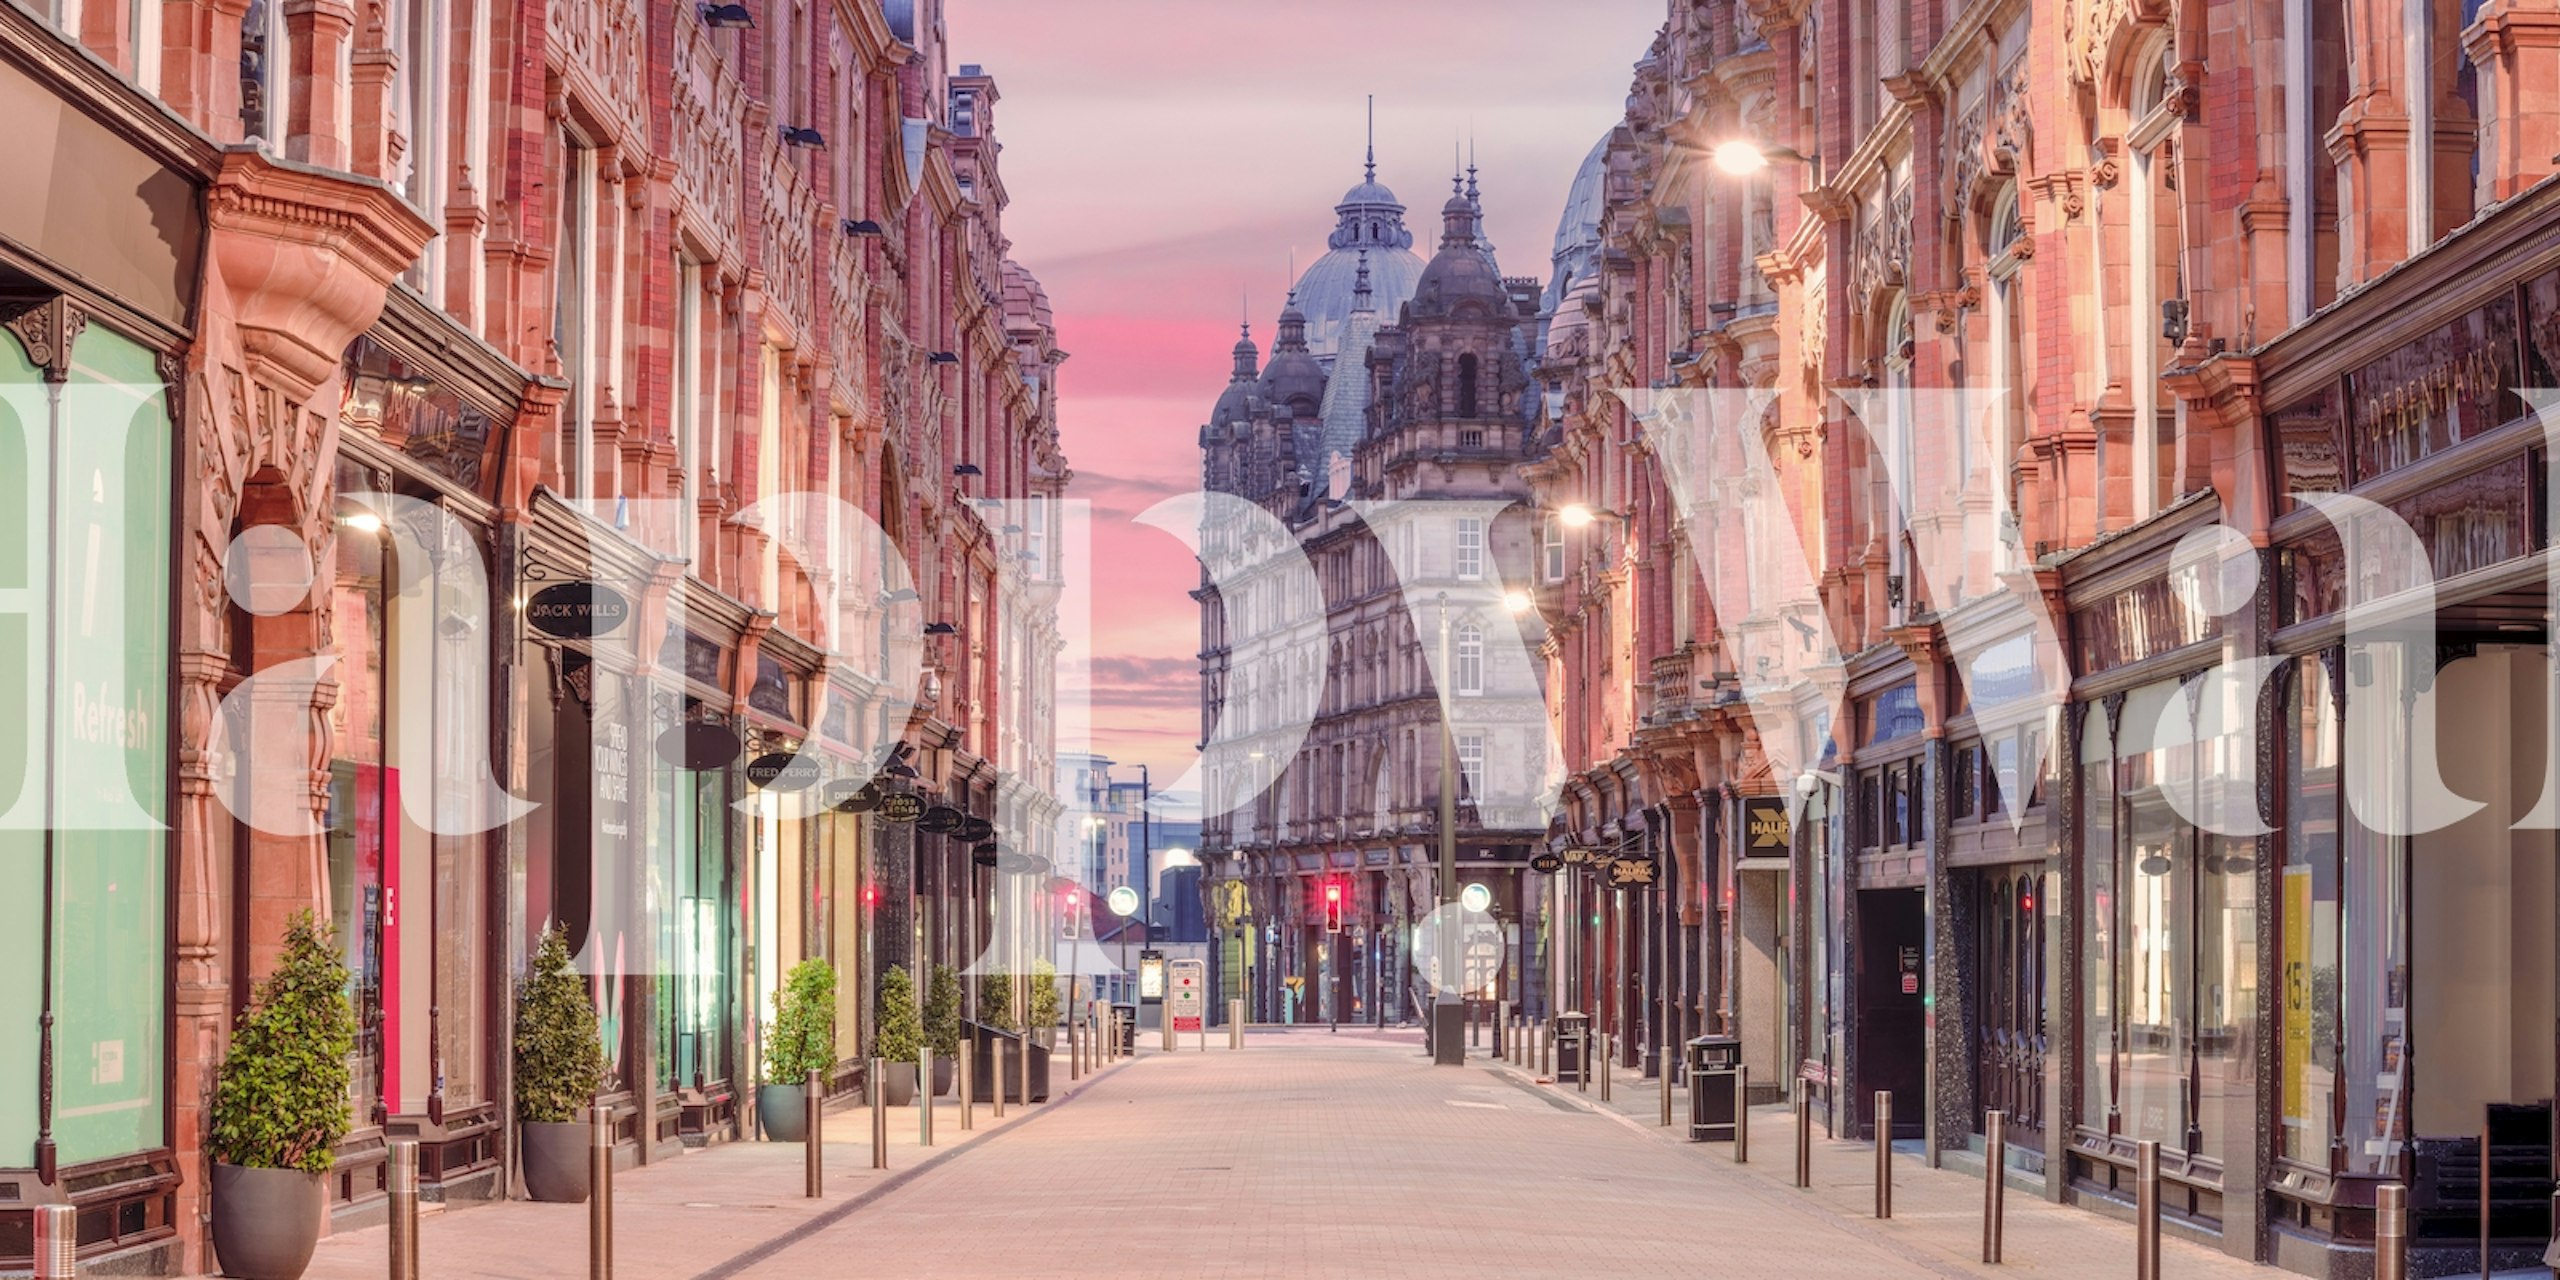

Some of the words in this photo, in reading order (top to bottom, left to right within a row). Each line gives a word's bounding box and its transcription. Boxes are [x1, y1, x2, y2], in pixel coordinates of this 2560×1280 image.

[2368, 341, 2500, 442] DEBENHAMS
[532, 603, 572, 618] JACK
[576, 603, 620, 618] WILLS
[73, 680, 148, 751] Refresh
[749, 767, 780, 778] FRED
[781, 767, 819, 778] PERRY
[834, 790, 867, 801] DIESEL
[1563, 850, 1588, 862] VAN
[1612, 866, 1655, 877] HALIFAX
